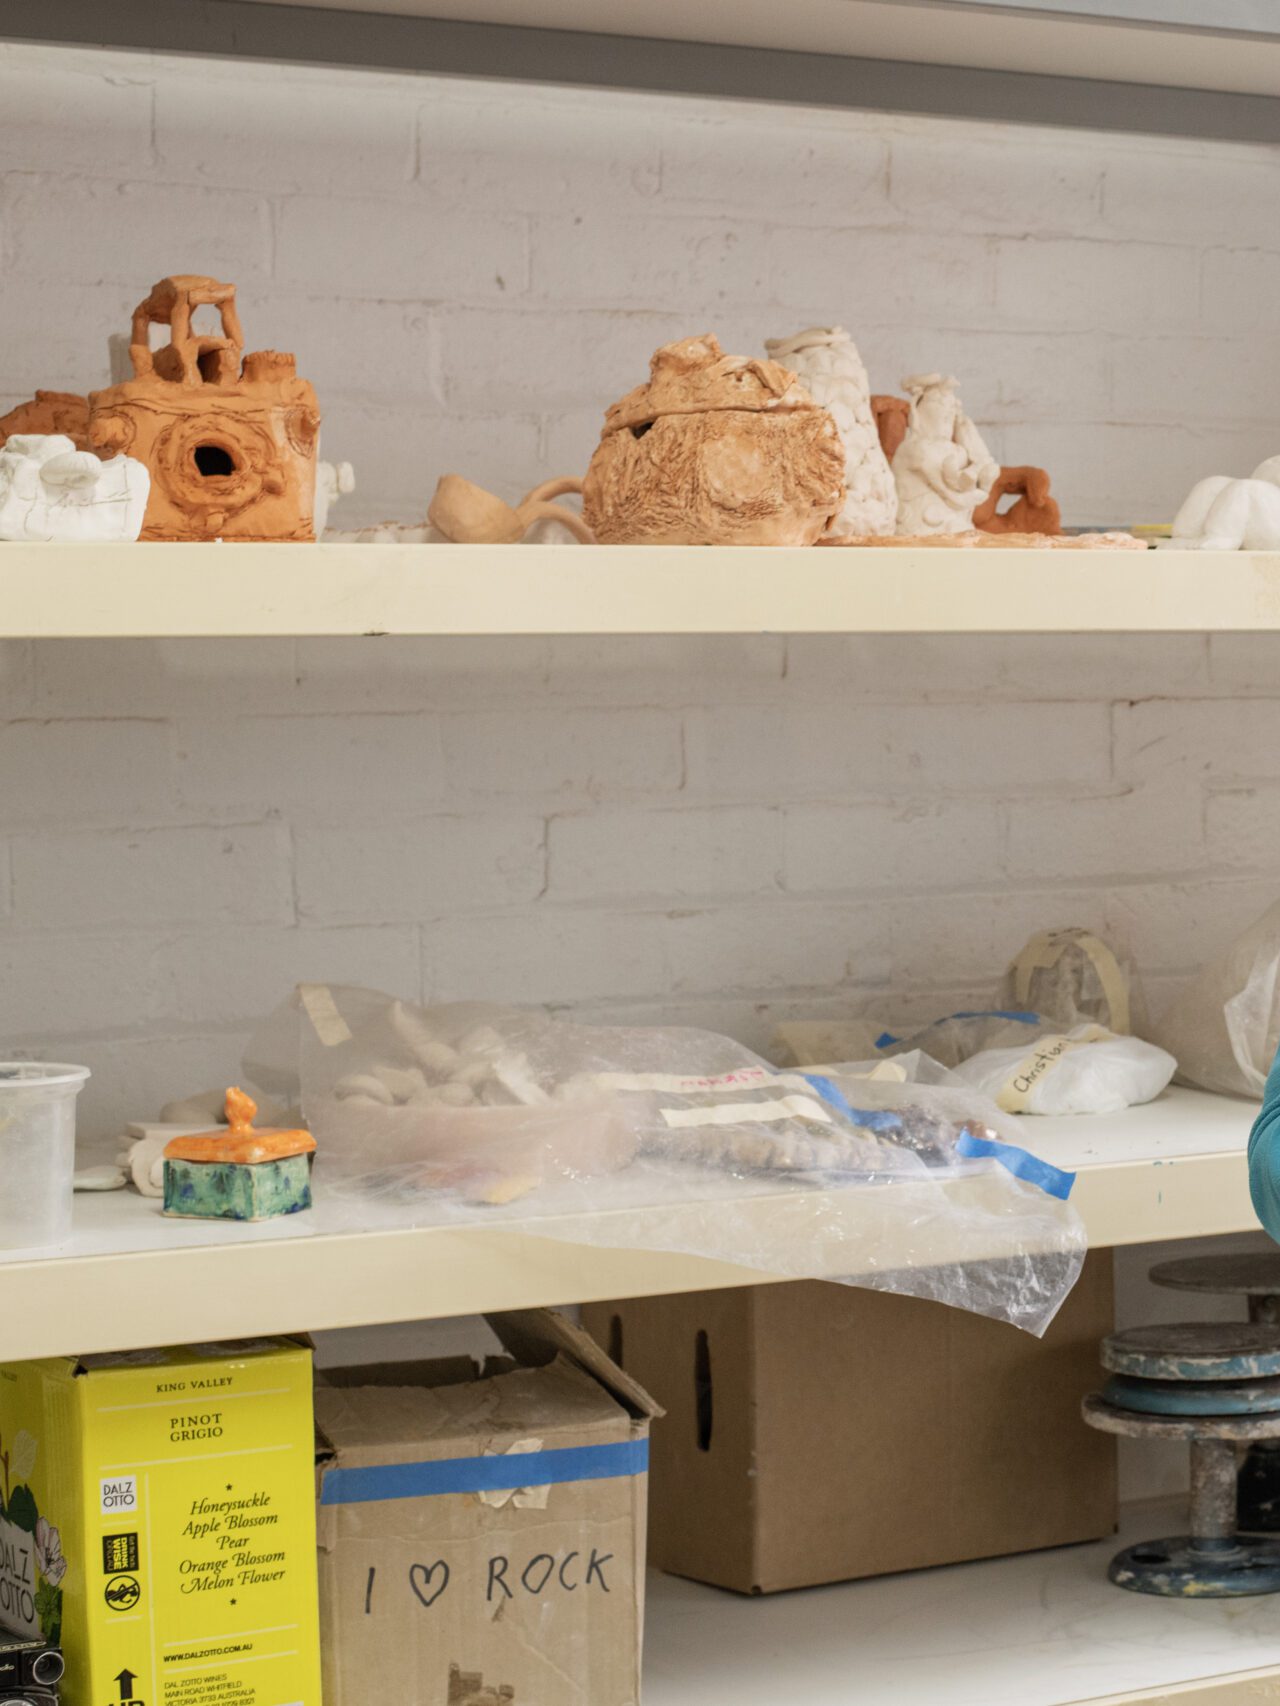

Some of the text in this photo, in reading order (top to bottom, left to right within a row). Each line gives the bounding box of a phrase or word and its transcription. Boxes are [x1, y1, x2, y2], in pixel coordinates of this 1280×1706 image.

[156, 1377, 233, 1393] KING VALLEY
[170, 1413, 222, 1429] PINOT
[170, 1427, 223, 1442] GRIGIO
[103, 1482, 133, 1495] DALZ
[103, 1494, 135, 1507] OTTO
[190, 1491, 271, 1516] Honeysuckle
[182, 1514, 279, 1540] Apple Blossom
[216, 1535, 250, 1551] Pear
[113, 1538, 122, 1570] WISE
[179, 1551, 286, 1575] Orange Blossom
[180, 1569, 286, 1594] Melon Flower
[365, 1549, 614, 1614] I ROCK
[0, 1577, 35, 1624] OTTO
[163, 1643, 253, 1662] WWW.DALZOTTO.COM.AU
